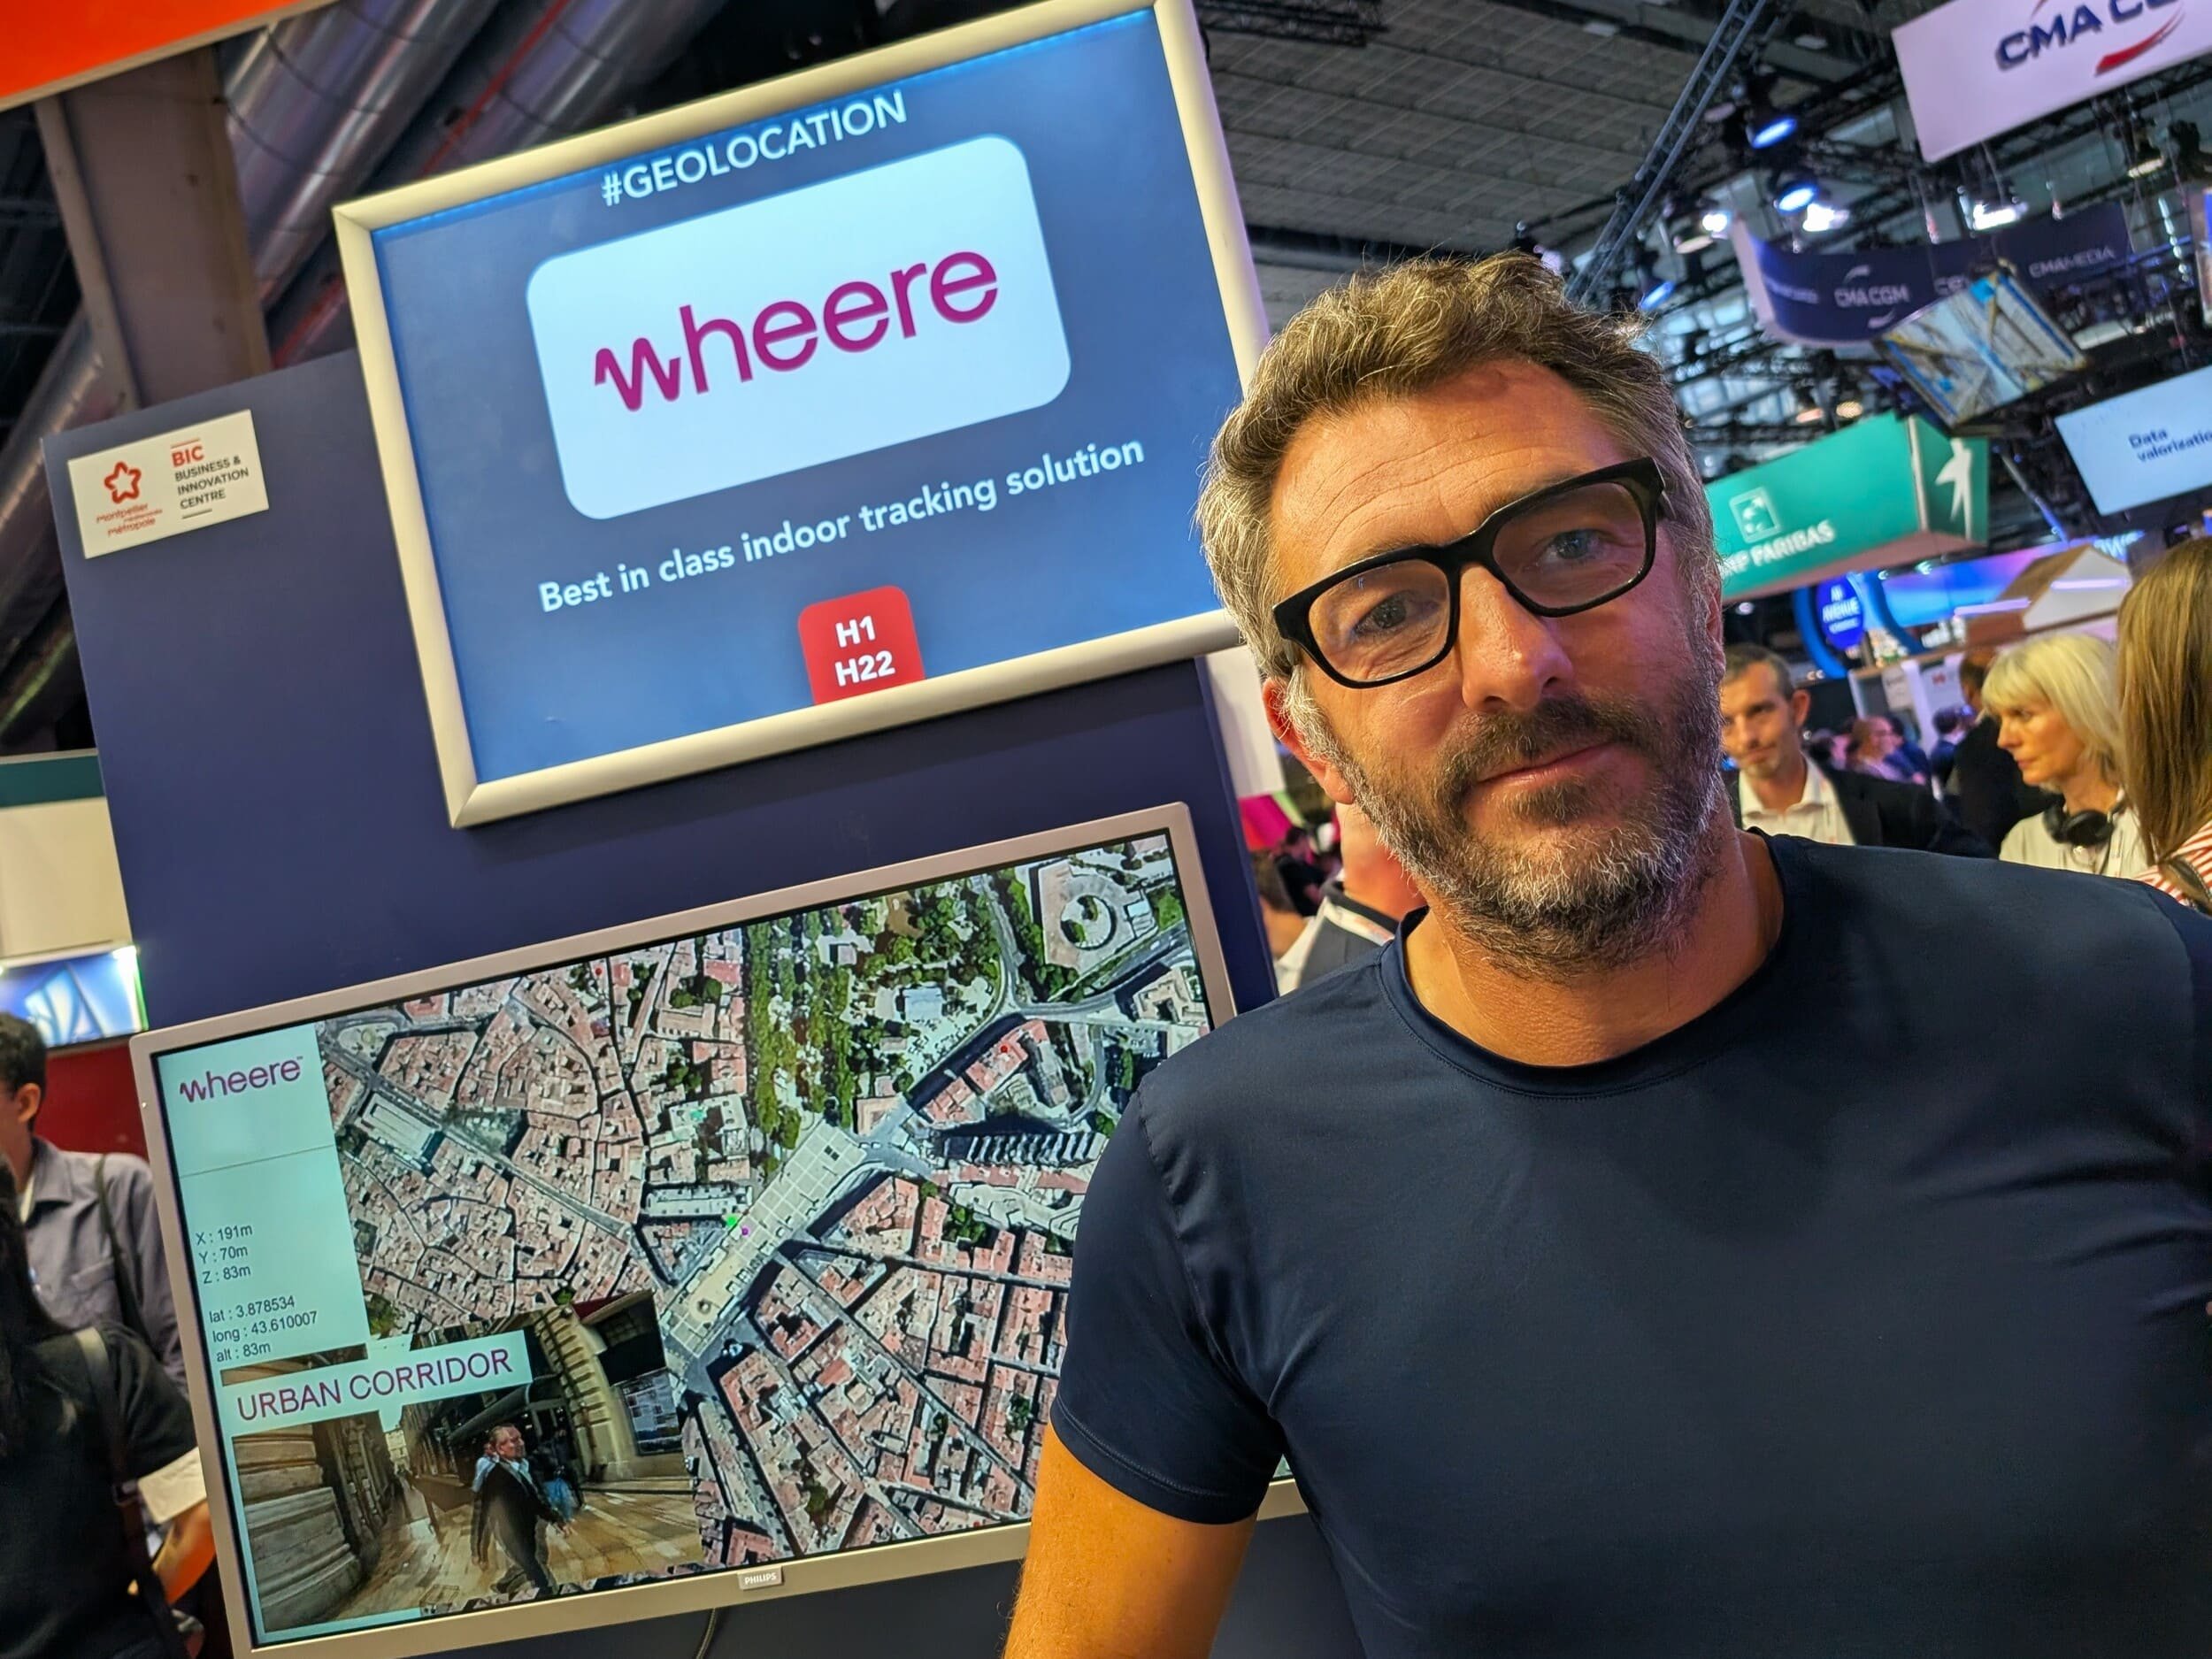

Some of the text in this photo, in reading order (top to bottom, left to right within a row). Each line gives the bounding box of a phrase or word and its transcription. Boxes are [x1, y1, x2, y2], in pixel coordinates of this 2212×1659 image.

[1995, 4, 2103, 73] CMA
[601, 90, 907, 207] #GEOLOCATION
[594, 250, 1000, 411] wheere
[2128, 428, 2168, 449] Data
[171, 446, 205, 468] BIC
[174, 455, 242, 483] BUSINESS &
[177, 467, 250, 496] INNOVATION
[180, 489, 227, 511] CENTRE
[538, 440, 1145, 613] Best in class indoor tracking solution
[1749, 518, 1836, 567] PARIBAS
[834, 614, 877, 649] H1
[834, 650, 896, 687] H22
[196, 1231, 206, 1246] X
[217, 1225, 254, 1241] 191m
[199, 1250, 209, 1264] Y
[219, 1246, 249, 1261] 70m
[203, 1271, 212, 1285] Z
[223, 1265, 251, 1280] 83m
[209, 1309, 226, 1323] lat
[235, 1294, 296, 1318] 3.878534
[212, 1328, 241, 1343] long
[250, 1310, 319, 1335] 43.610007
[216, 1348, 233, 1363] alt
[242, 1342, 272, 1358] 83m
[236, 1348, 513, 1422] URBAN CORRIDOR
[744, 1571, 777, 1586] PHILIPS
